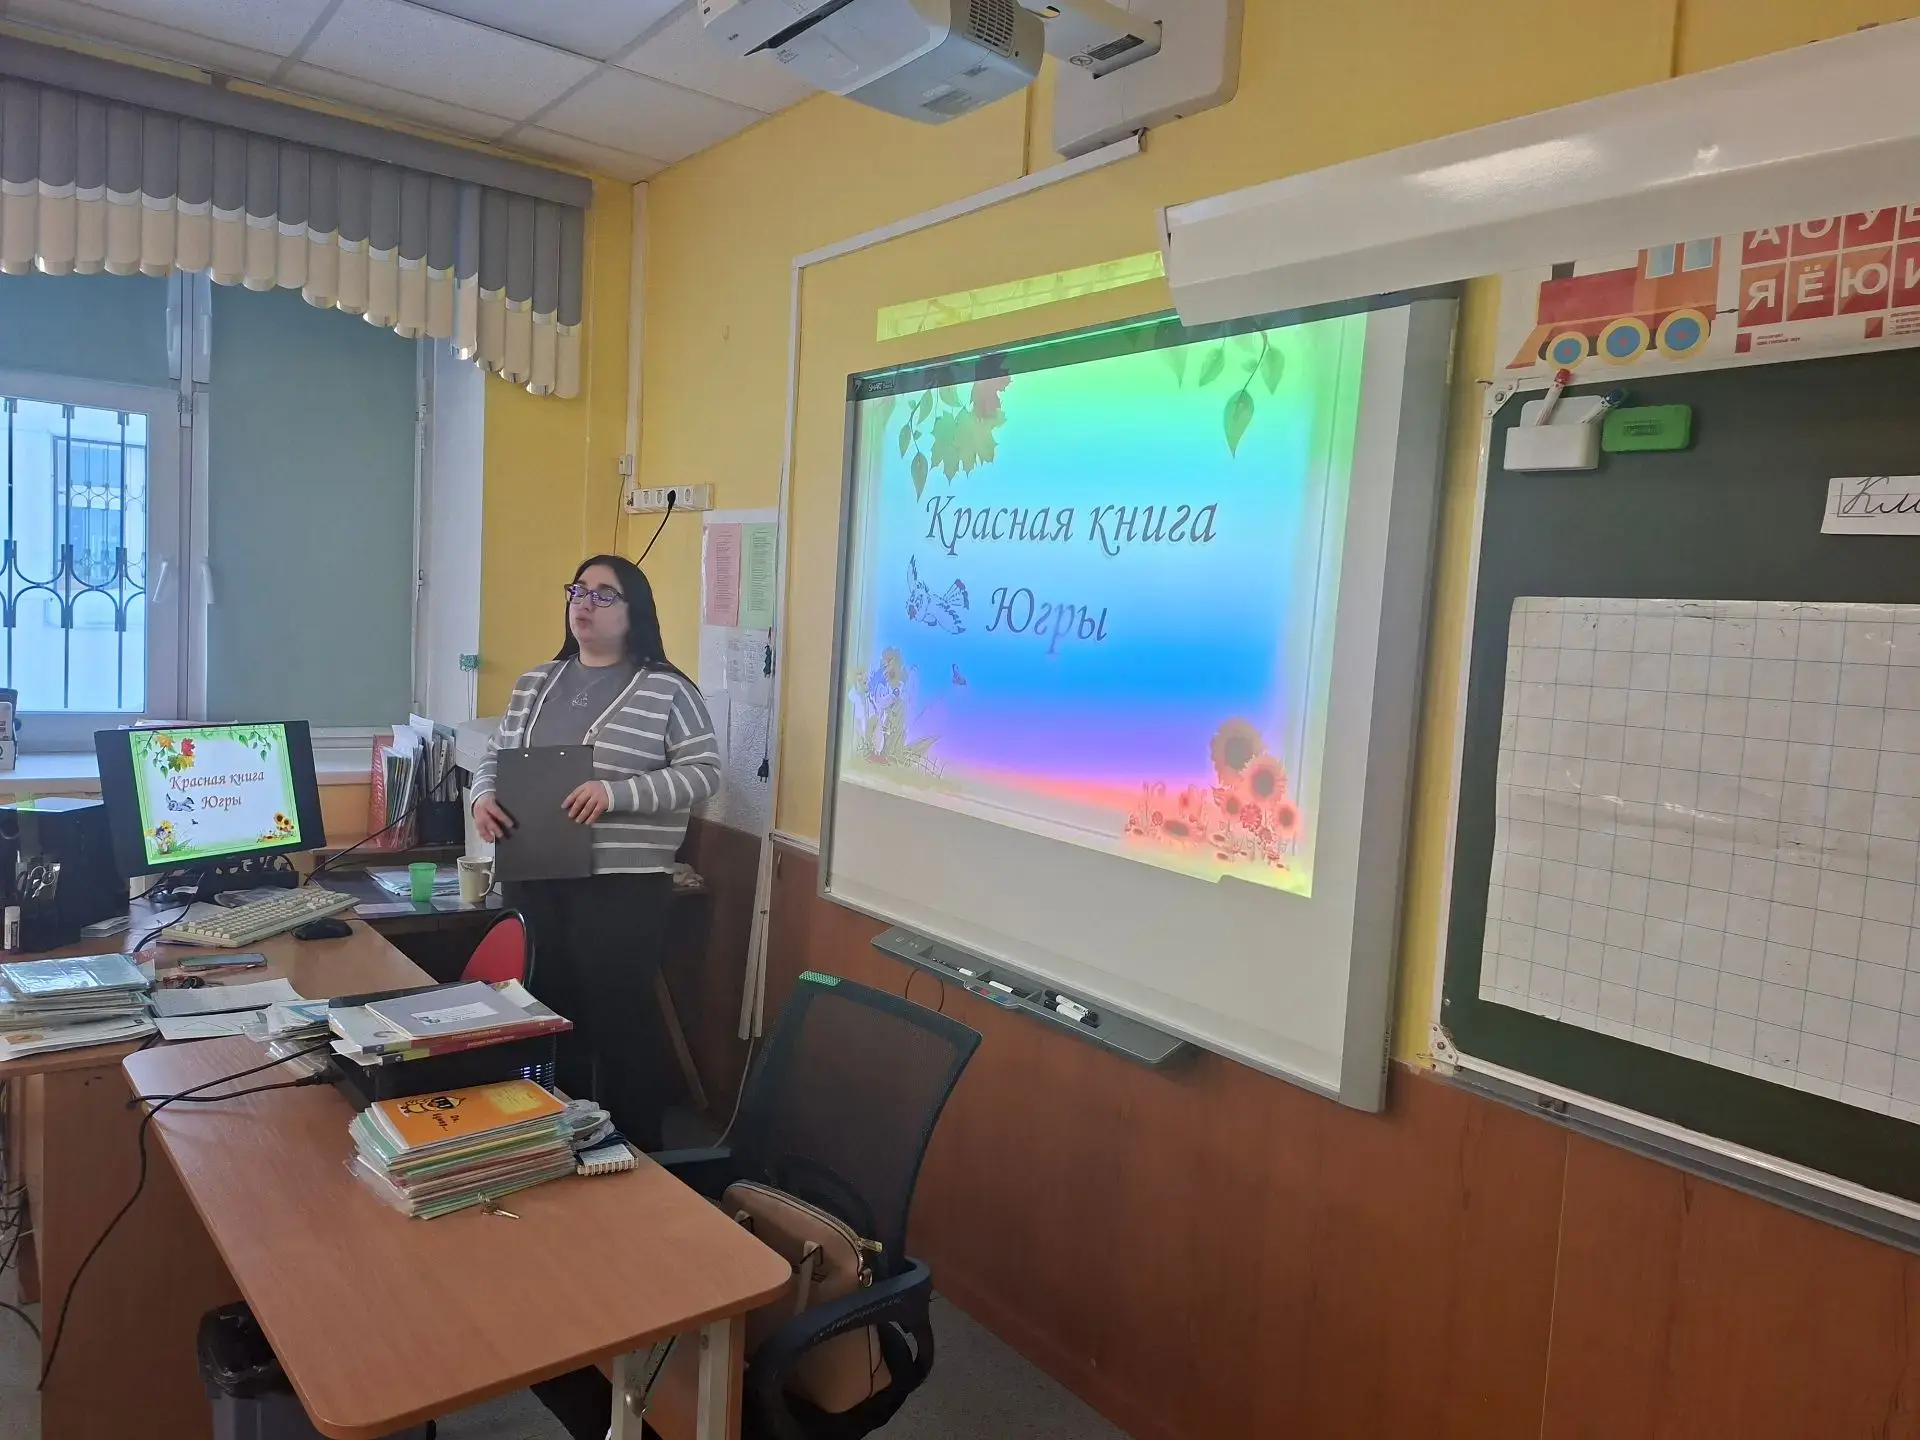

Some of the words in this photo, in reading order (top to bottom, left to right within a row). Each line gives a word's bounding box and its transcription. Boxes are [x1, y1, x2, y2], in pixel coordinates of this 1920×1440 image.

[1746, 278, 1776, 311] Я
[1797, 264, 1825, 304] Ё
[1840, 262, 1889, 298] Ю
[926, 495, 1075, 556] Красная
[1088, 502, 1219, 556] книга
[985, 587, 1108, 655] Югры
[169, 775, 226, 793] Красная
[229, 771, 265, 787] книга
[201, 795, 242, 812] Югры
